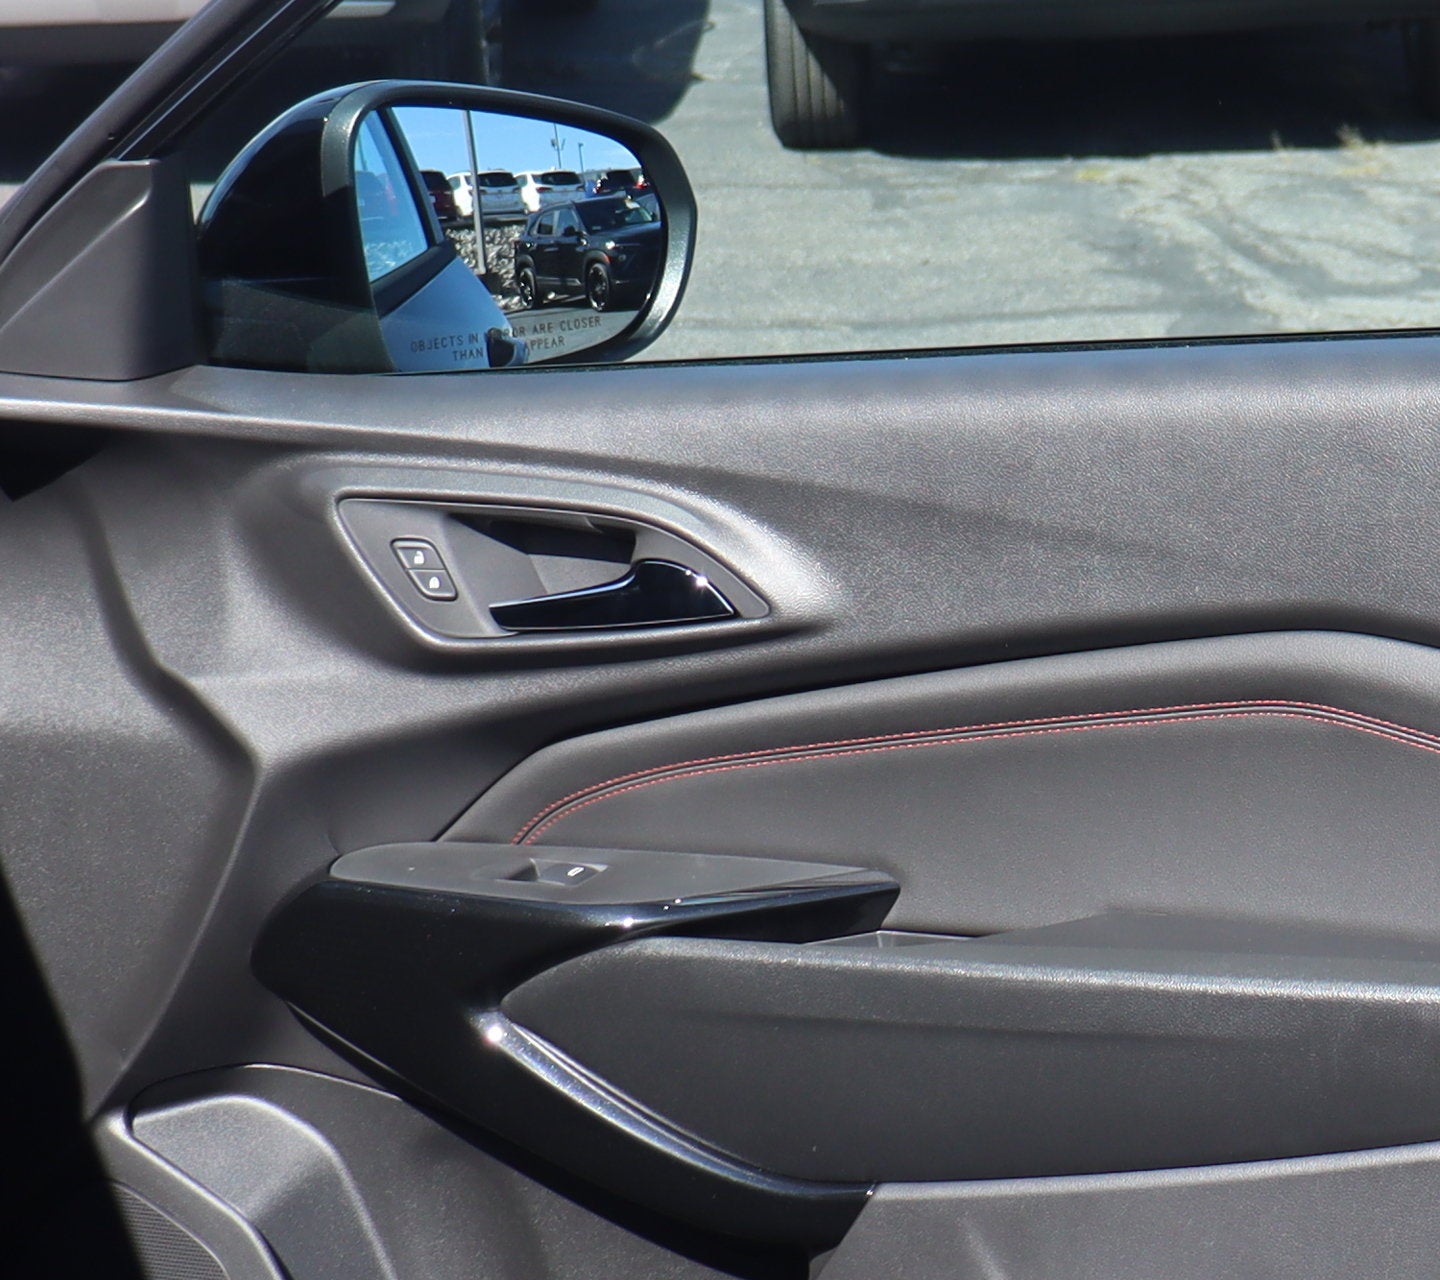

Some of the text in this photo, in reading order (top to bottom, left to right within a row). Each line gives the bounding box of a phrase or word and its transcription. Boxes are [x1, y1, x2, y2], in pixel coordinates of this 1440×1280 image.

[411, 334, 464, 352] OBJECTS
[468, 333, 479, 344] IN
[532, 321, 554, 334] ARE
[559, 316, 602, 330] CLOSER
[452, 347, 484, 361] THAN
